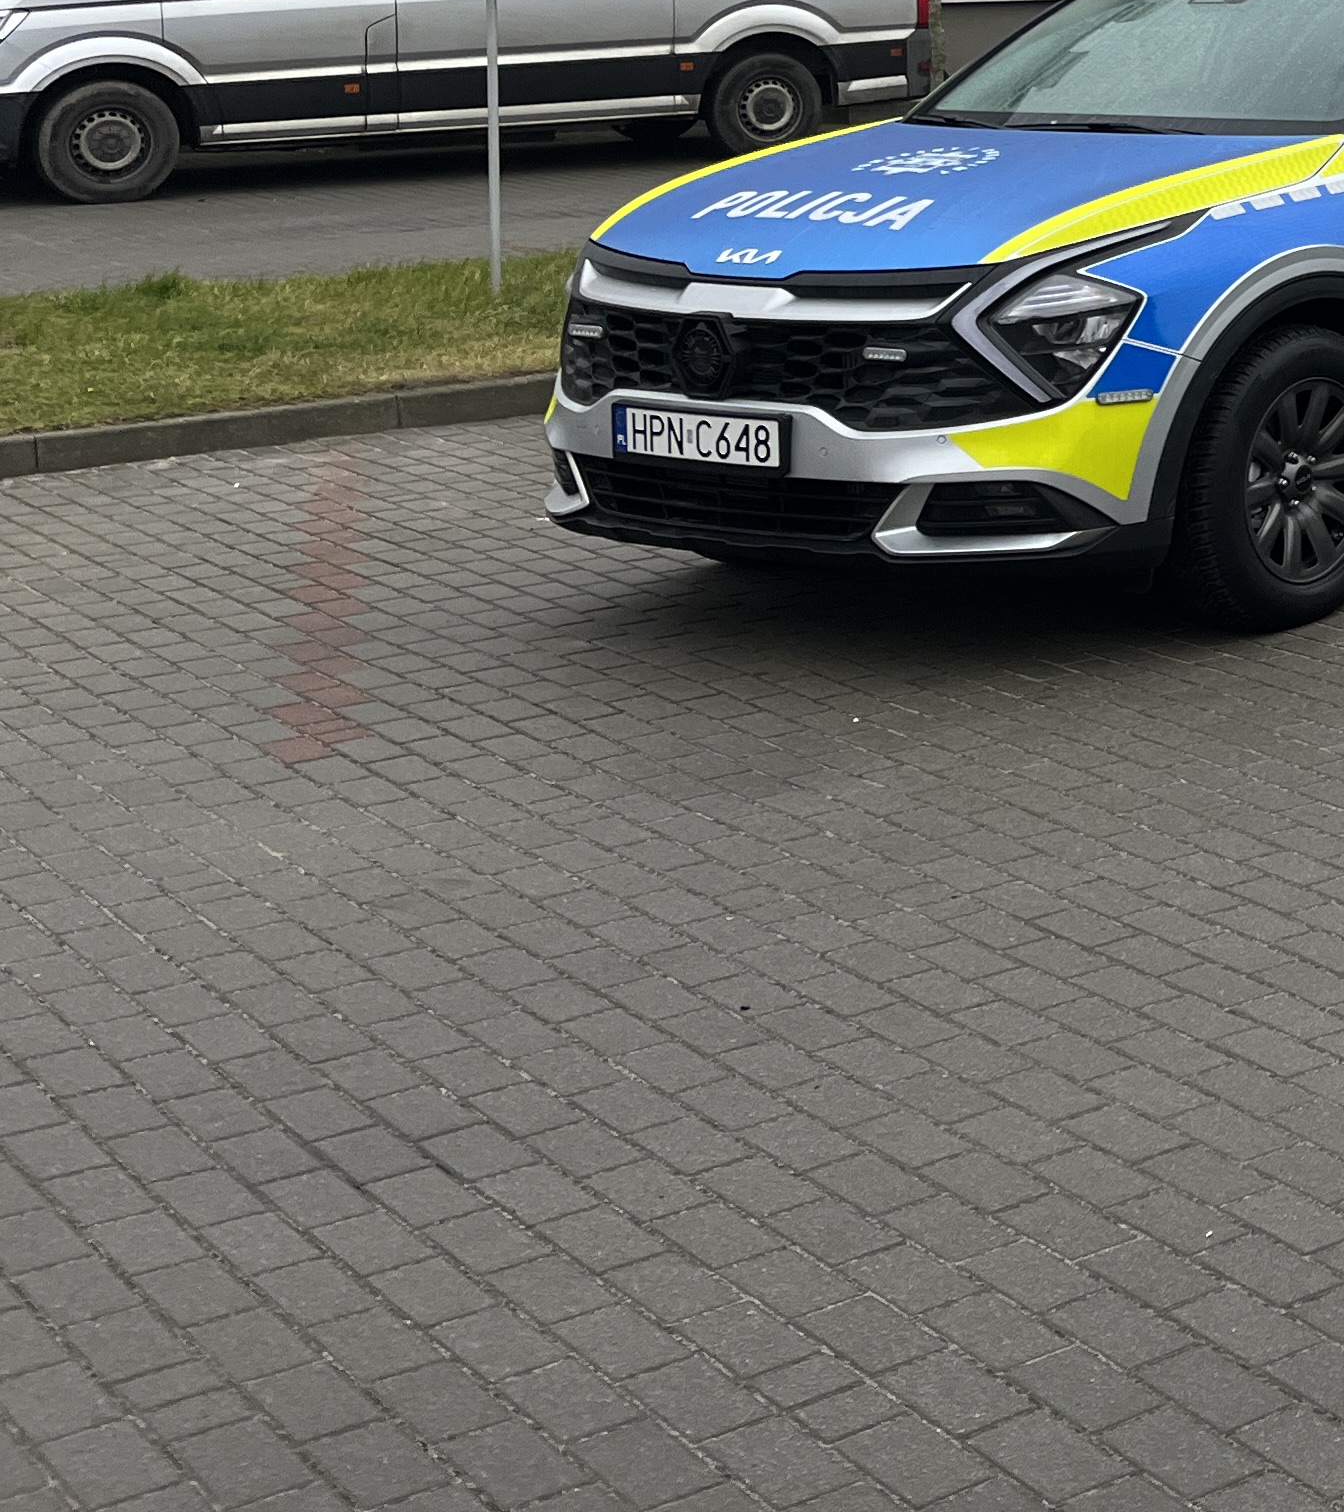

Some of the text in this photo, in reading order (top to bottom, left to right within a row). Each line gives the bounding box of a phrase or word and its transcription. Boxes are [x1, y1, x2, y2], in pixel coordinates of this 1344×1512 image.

[691, 190, 936, 230] POLICJA
[616, 412, 771, 464] PL HPN C648
